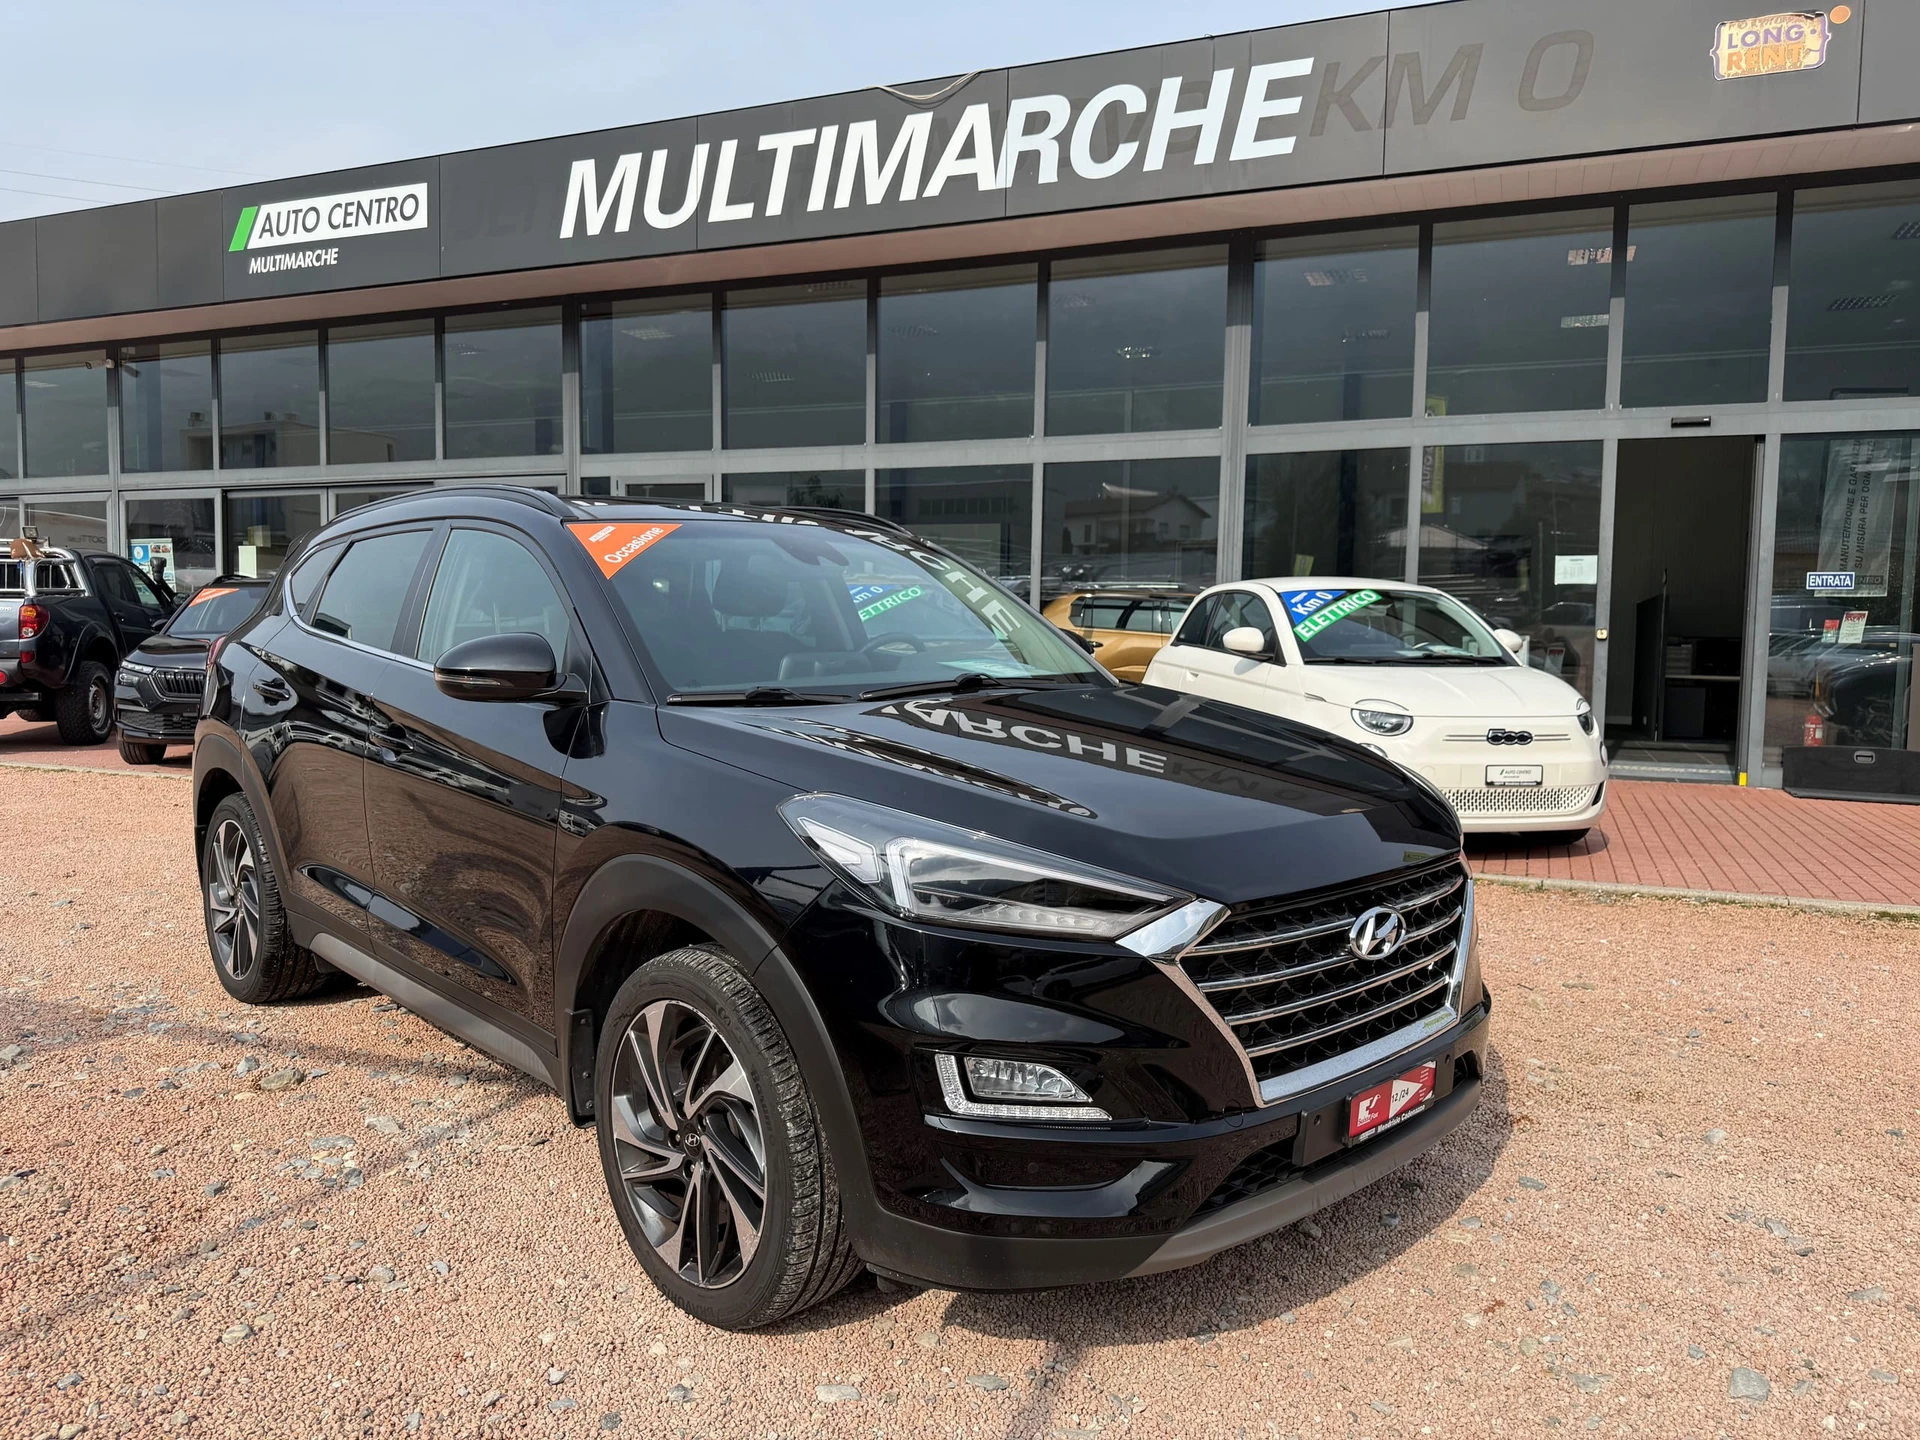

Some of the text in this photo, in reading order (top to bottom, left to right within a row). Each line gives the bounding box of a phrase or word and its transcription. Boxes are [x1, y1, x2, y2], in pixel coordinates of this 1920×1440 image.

[1727, 24, 1805, 49] LONG
[1727, 43, 1804, 70] RENT
[559, 57, 1315, 239] MULTIMARCHE
[1309, 43, 1484, 137] KM
[258, 193, 419, 239] AUTO CENTRO
[249, 248, 339, 275] MULTIMARCHE
[1859, 496, 1869, 515] PER
[603, 526, 665, 563] Occasione
[1856, 517, 1867, 554] MISURA
[1854, 556, 1863, 569] SU
[1809, 575, 1852, 587] ENTRATA
[858, 586, 922, 620] ETTRICO
[1292, 598, 1325, 615] Km
[1299, 590, 1377, 637] ELETTRICO
[1486, 728, 1533, 745] 500
